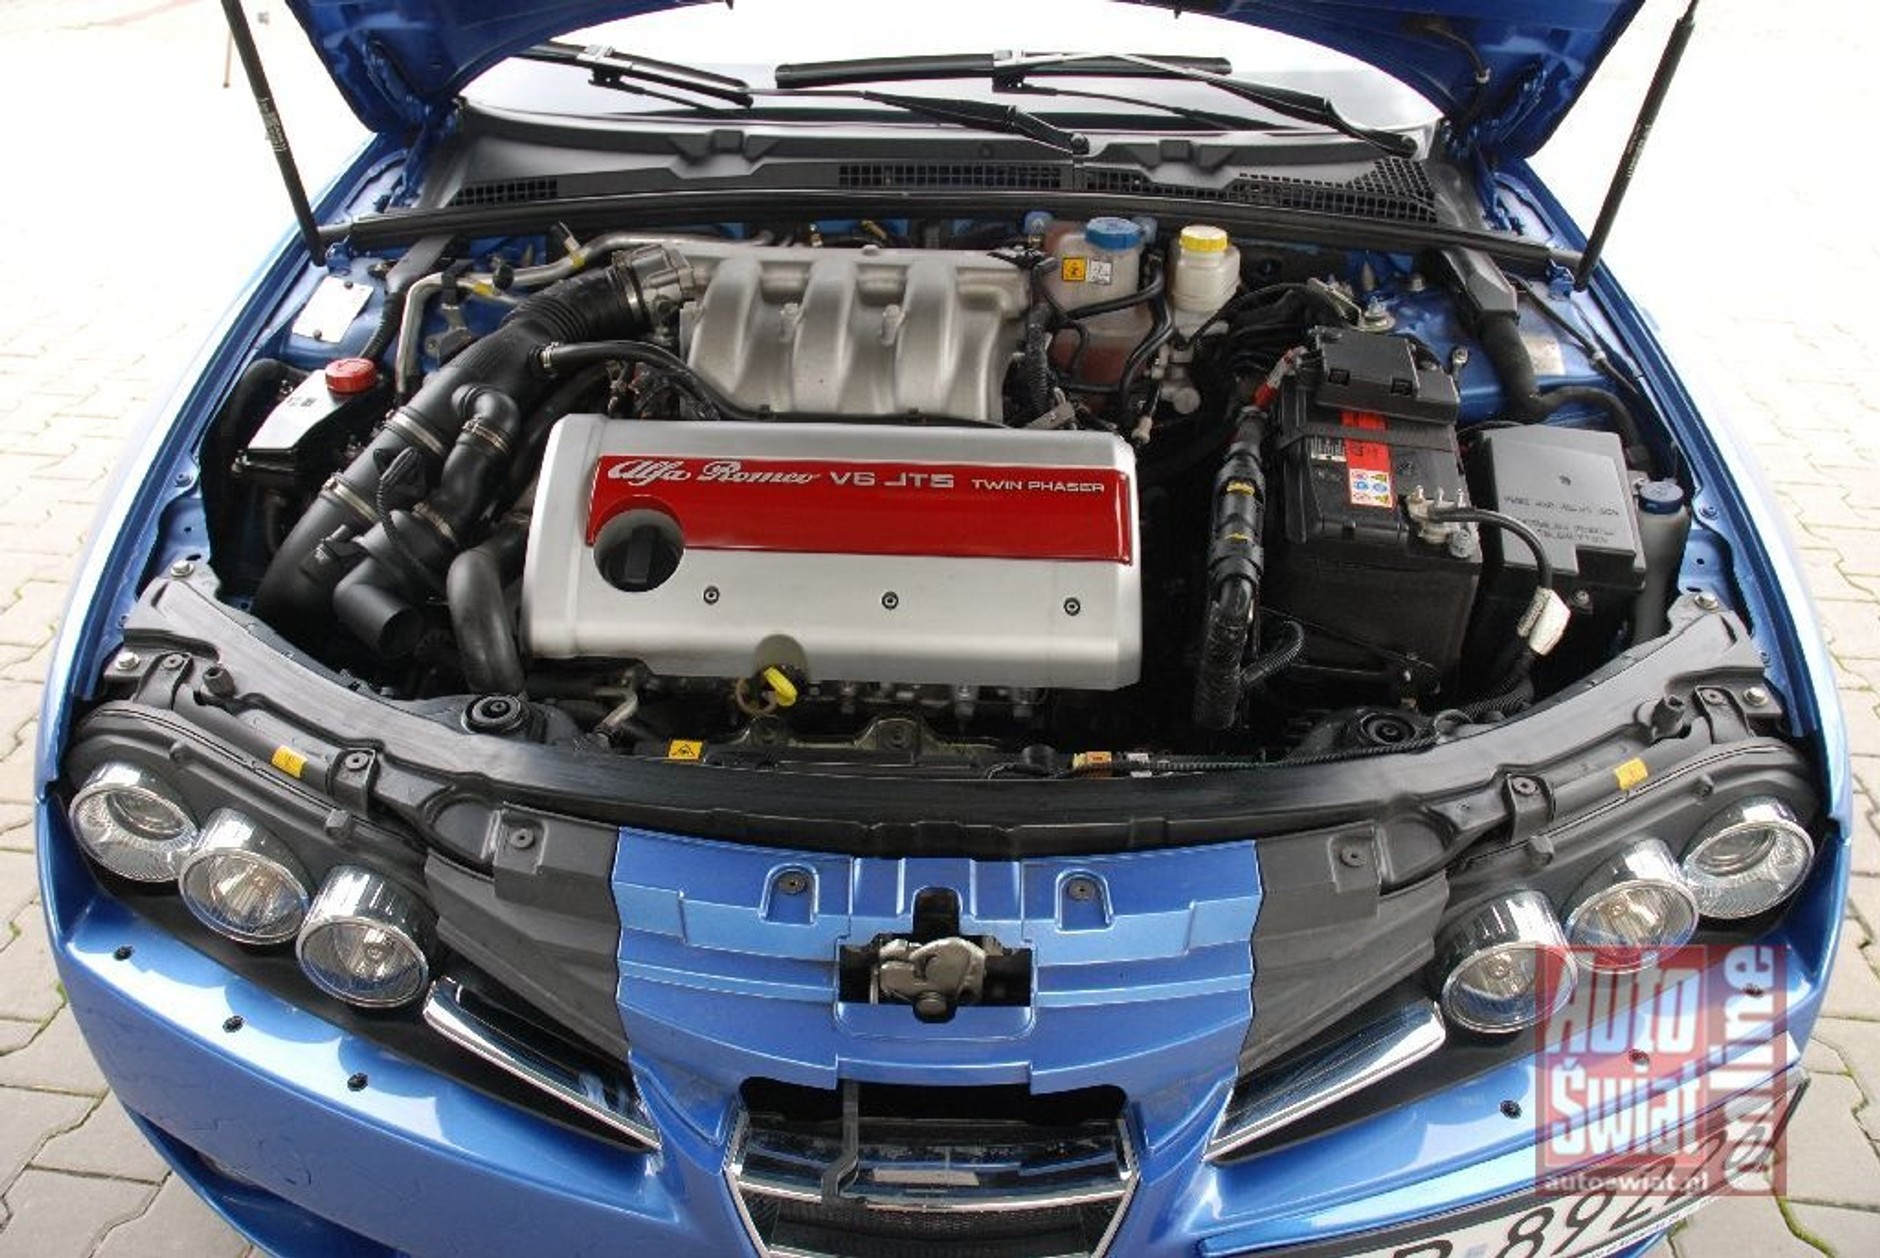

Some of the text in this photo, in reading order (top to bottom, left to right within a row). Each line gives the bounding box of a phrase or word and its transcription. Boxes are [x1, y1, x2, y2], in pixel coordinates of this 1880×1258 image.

[607, 459, 692, 487] Alfa
[696, 460, 821, 484] Romeo
[830, 471, 876, 487] V6
[971, 479, 1105, 493] TWIN PHASER
